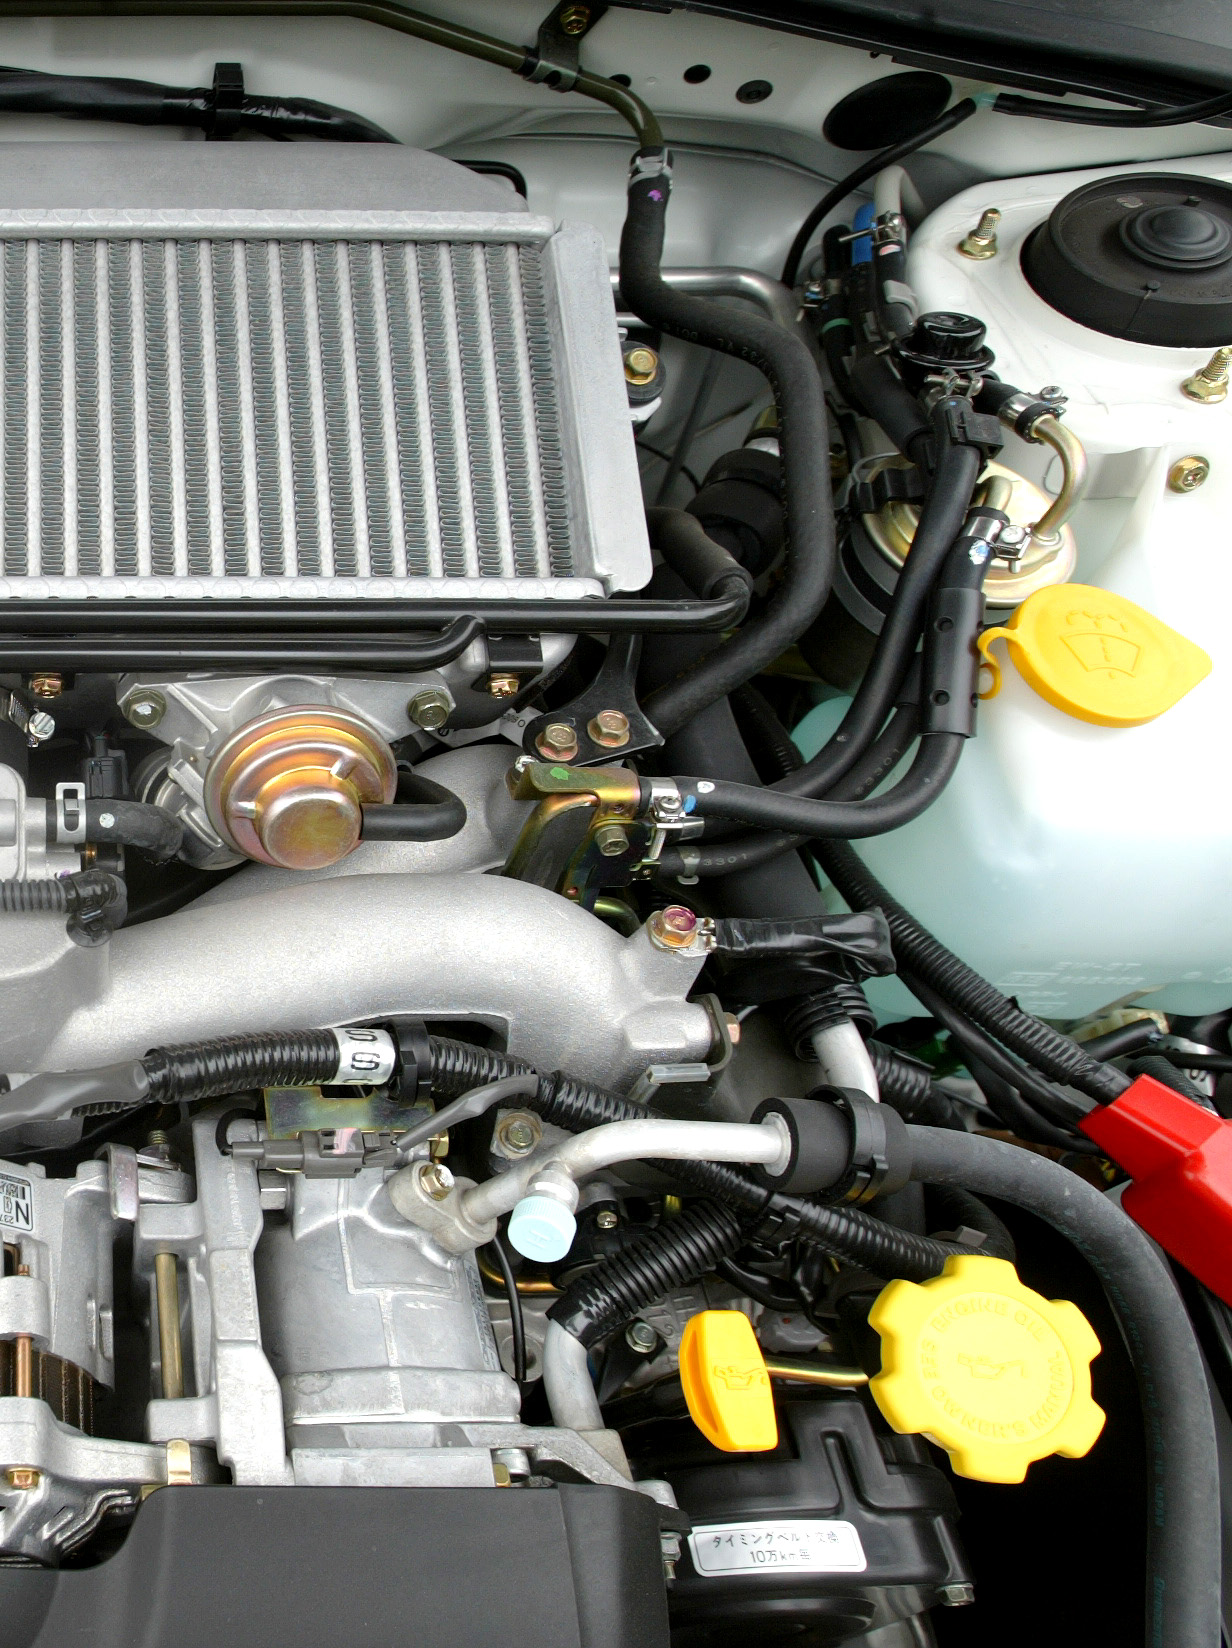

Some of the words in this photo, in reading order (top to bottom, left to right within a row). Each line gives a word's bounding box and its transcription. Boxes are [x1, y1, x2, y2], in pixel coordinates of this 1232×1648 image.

[930, 1297, 1009, 1333] ENGINE
[1014, 1310, 1049, 1342] OIL
[932, 1386, 1027, 1438] OWNER'S
[1029, 1350, 1066, 1430] MANUAL
